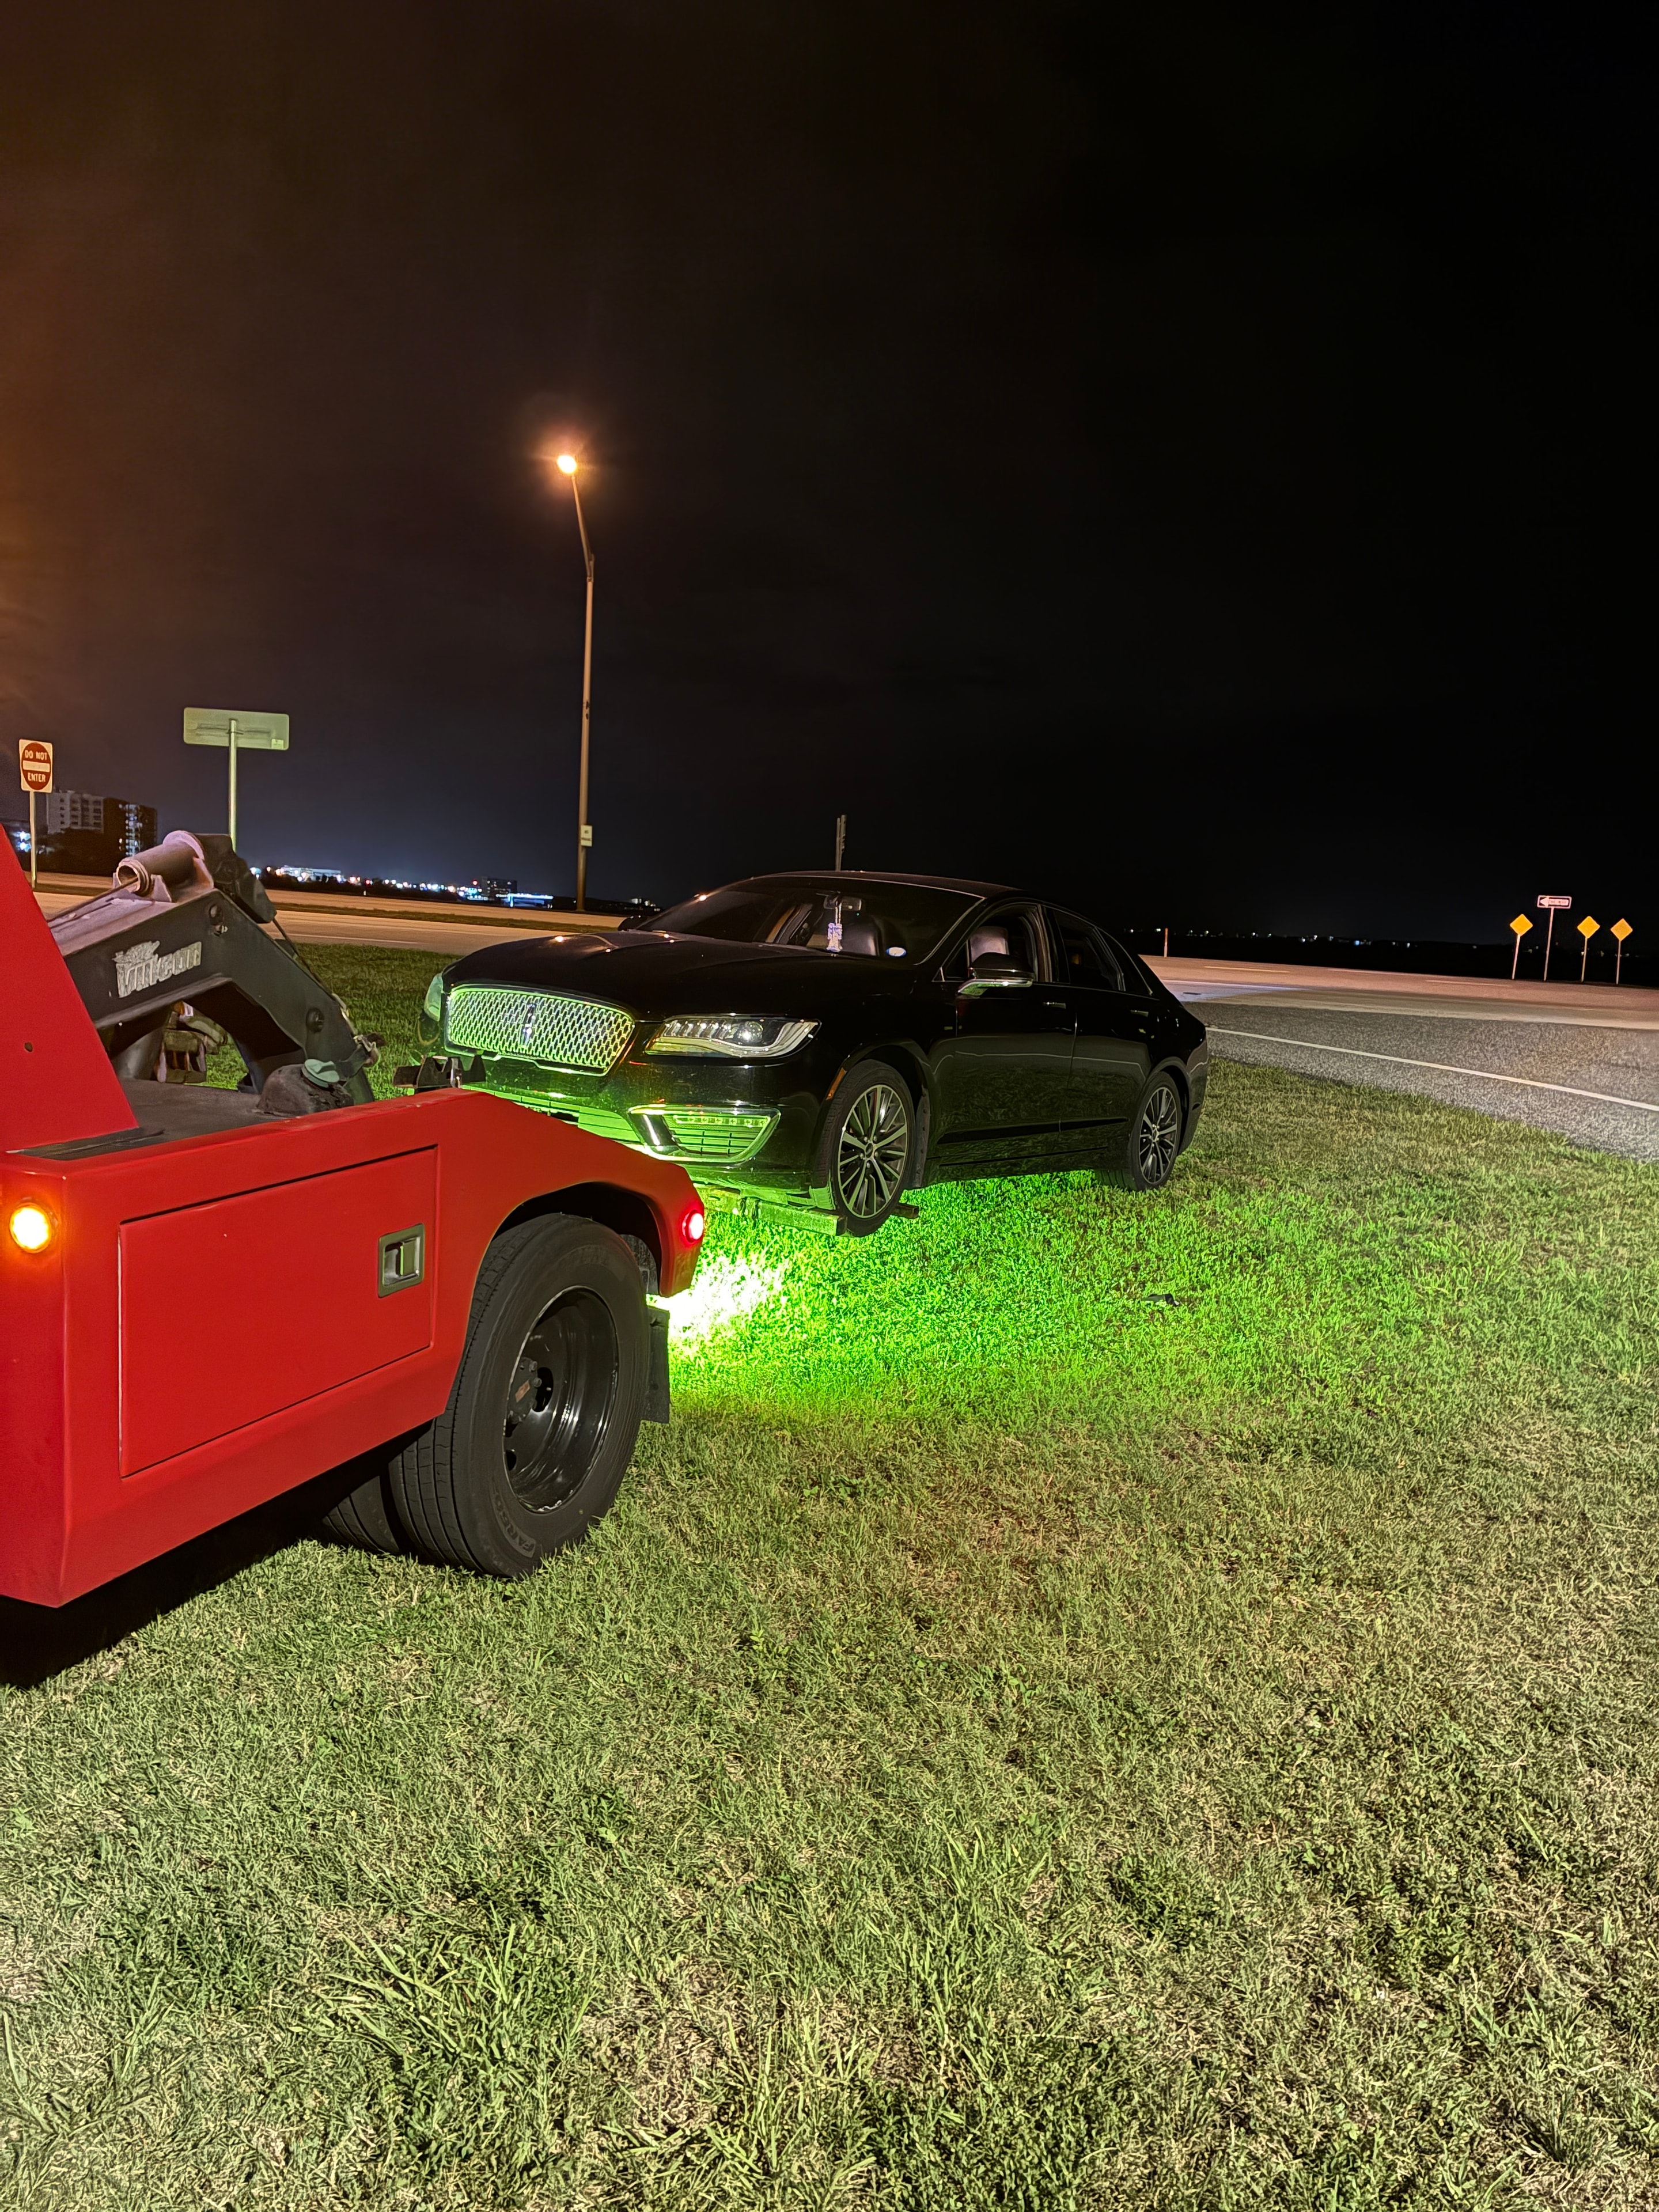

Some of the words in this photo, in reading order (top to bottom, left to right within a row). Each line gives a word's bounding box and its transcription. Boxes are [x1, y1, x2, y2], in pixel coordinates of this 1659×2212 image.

[24, 749, 33, 759] DO
[36, 751, 47, 760] NOT
[27, 772, 46, 782] ENTER
